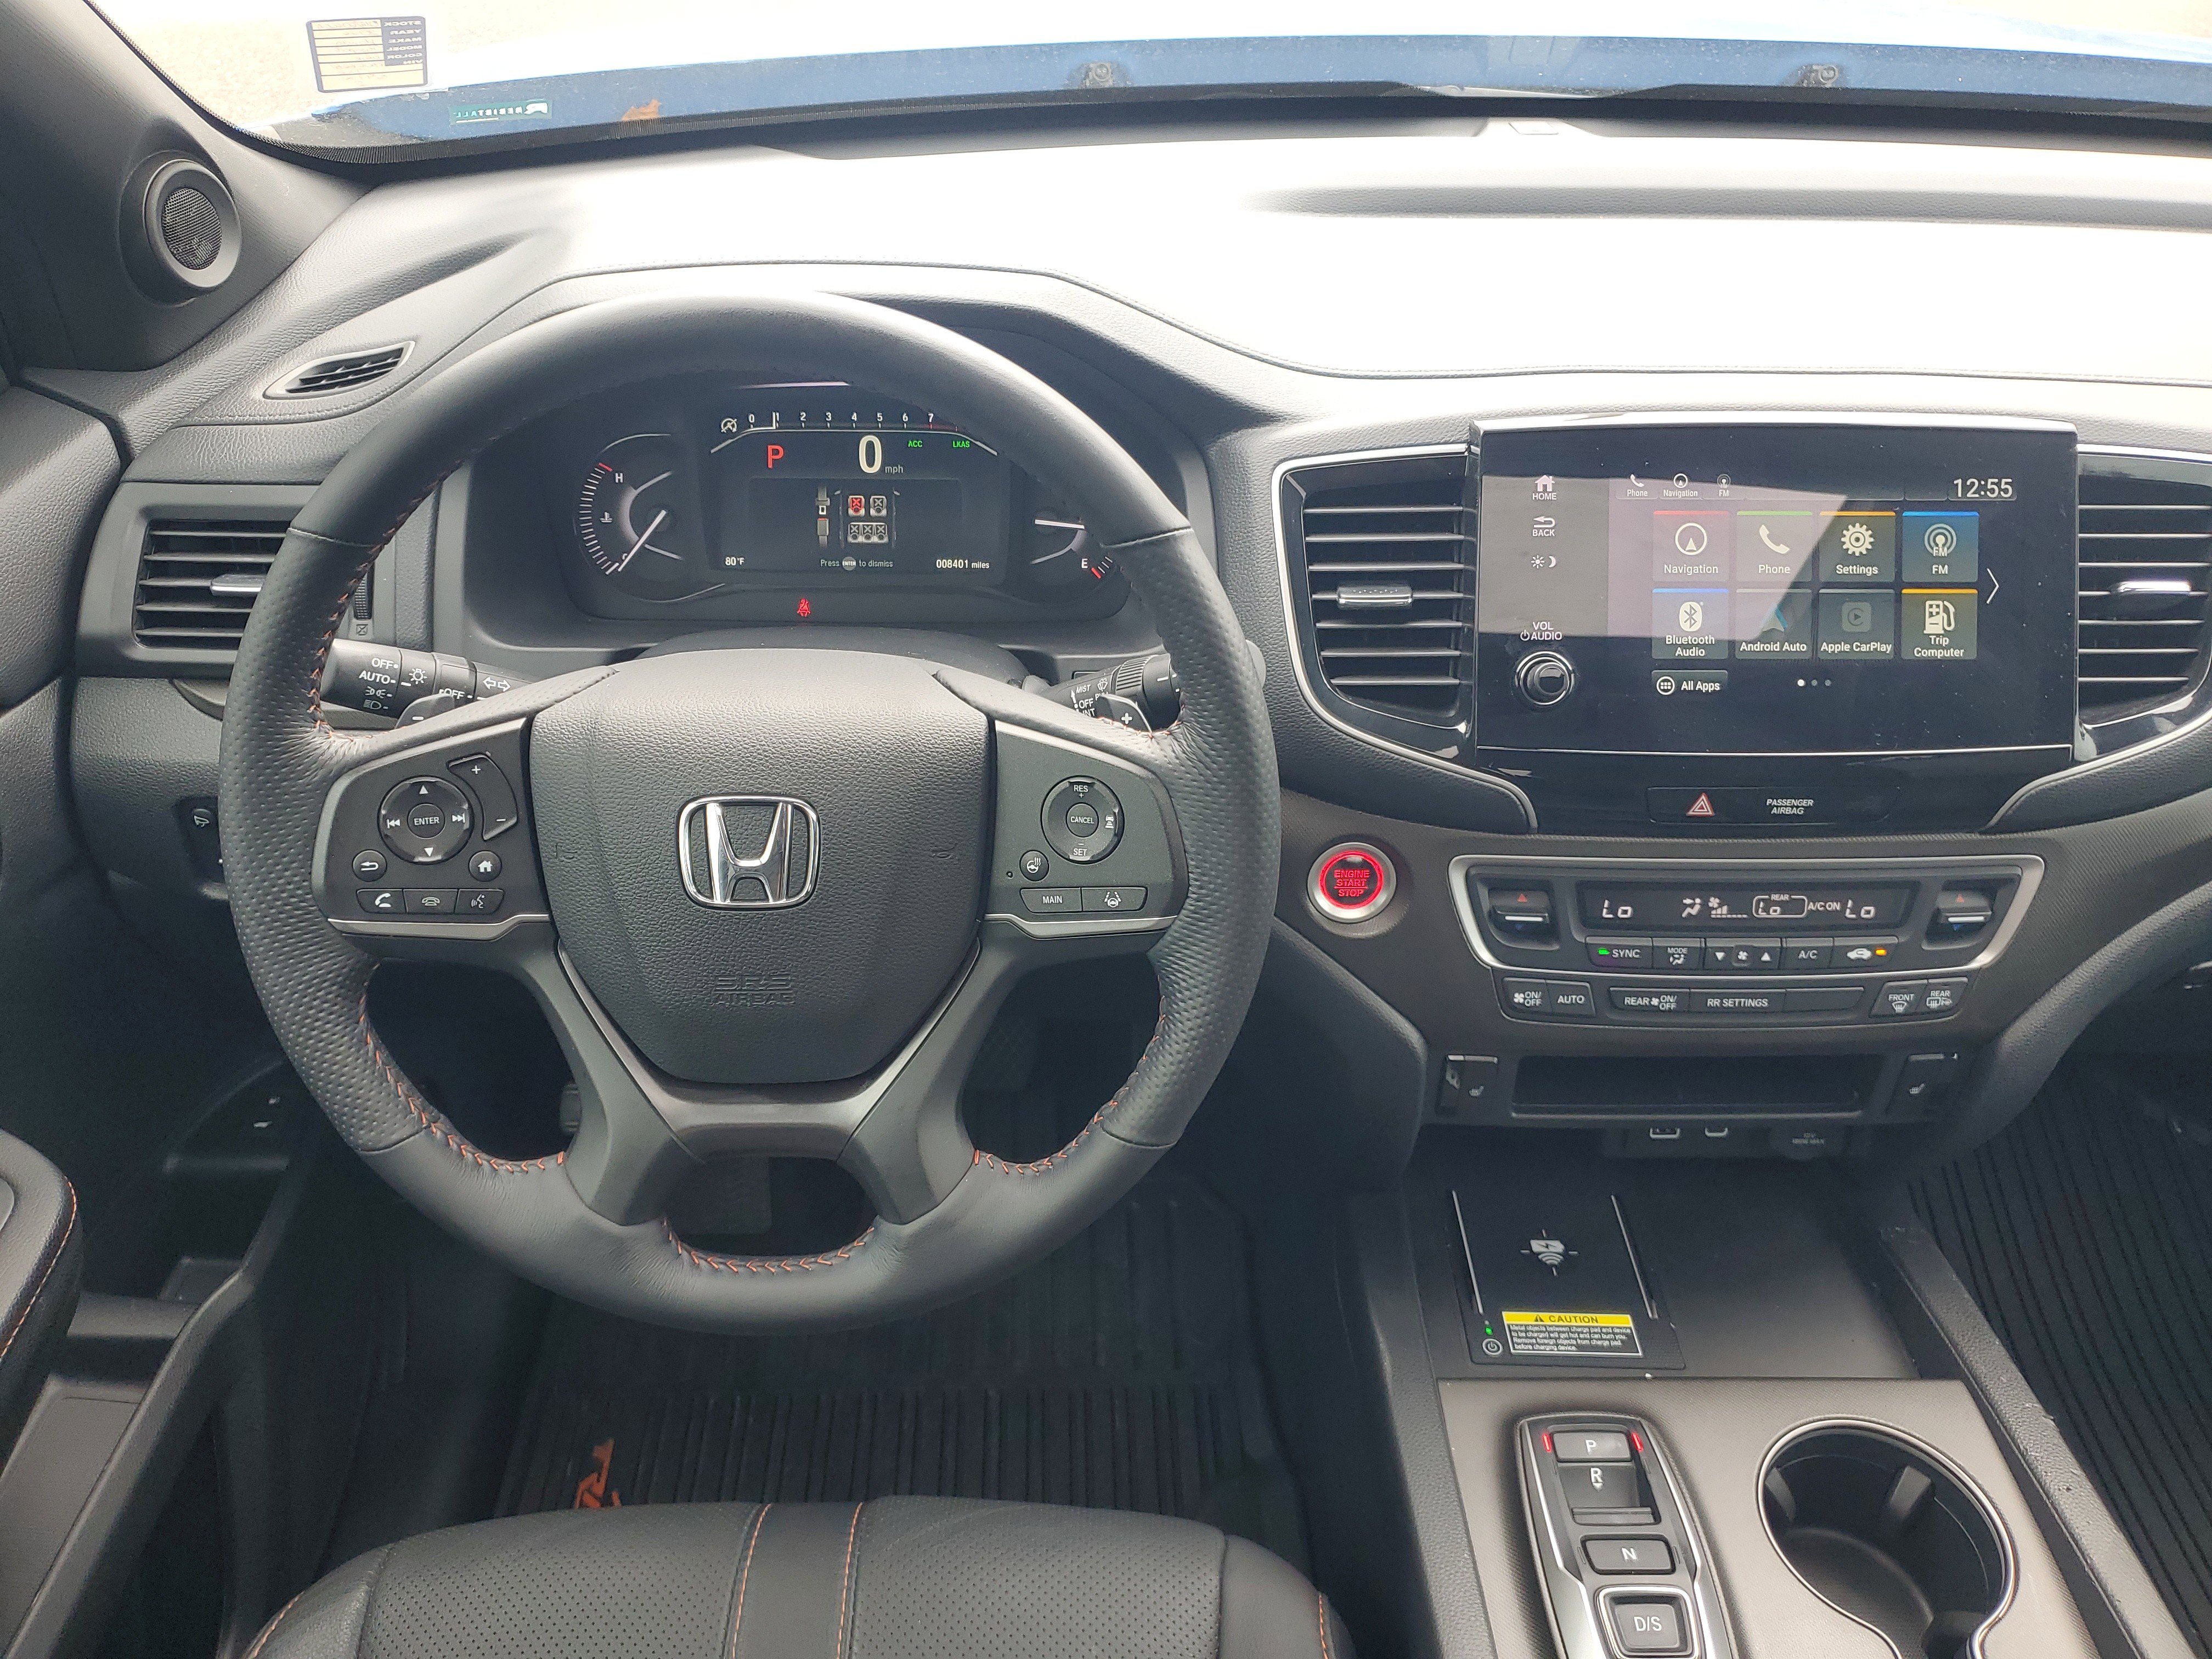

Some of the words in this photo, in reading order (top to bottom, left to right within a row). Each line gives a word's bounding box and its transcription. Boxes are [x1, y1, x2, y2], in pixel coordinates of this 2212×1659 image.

[748, 414, 755, 423] 0
[800, 412, 806, 421] 2
[825, 412, 832, 421] 3
[850, 412, 857, 421] 4
[877, 413, 883, 422] 5
[902, 413, 908, 422] 6
[928, 413, 934, 422] 7
[768, 444, 784, 469] P
[858, 435, 882, 473] 0
[884, 465, 904, 474] mph
[615, 472, 623, 483] H
[1954, 478, 2013, 498] 12:55
[1532, 493, 1557, 501] HOME
[1663, 489, 1698, 498] Navigation
[1532, 529, 1555, 537] BACK
[1933, 547, 1948, 557] FM
[725, 556, 745, 566] 80°F
[820, 559, 840, 568] Press
[868, 559, 894, 568] dismiss
[936, 559, 969, 569] 008401
[971, 560, 990, 570] miles
[1081, 558, 1088, 568] E
[1663, 565, 1719, 575] Navigation
[1758, 565, 1791, 574] Phone
[1836, 564, 1878, 576] Settings
[1932, 565, 1949, 574] FM
[1532, 622, 1554, 631] VOL
[1531, 631, 1562, 641] AUDIO
[1665, 635, 1715, 645] Bluetooth
[1928, 635, 1949, 646] Trip
[1675, 646, 1705, 657] Audio
[1740, 641, 1780, 652] Android
[1782, 642, 1807, 652] Auto
[1820, 642, 1850, 653] Apple
[1853, 642, 1892, 654] CarPlay
[1914, 647, 1965, 658] Computer
[371, 657, 394, 669] OFF
[358, 670, 391, 684] AUTO
[1076, 684, 1091, 694] MIST
[1681, 681, 1694, 691] All
[1696, 681, 1721, 692] Apps
[1079, 698, 1094, 709] OFF
[1074, 785, 1088, 793] RES
[1766, 798, 1814, 806] PASSENGER
[1770, 806, 1805, 815] AIRBAG
[414, 816, 439, 826] ENTER
[1070, 816, 1095, 825] CANCEL
[1073, 848, 1087, 856] SET
[1334, 869, 1370, 878] ENGINE
[1338, 889, 1364, 897] STOP
[1042, 895, 1063, 904] MAIN
[1602, 899, 1634, 919] Lo
[1758, 901, 1781, 915] Lo
[1808, 902, 1826, 911] A/C
[1826, 902, 1841, 911] ON
[1845, 899, 1876, 919] Lo
[1611, 949, 1641, 959] SYNC
[1798, 950, 1818, 960] A/C
[1524, 991, 1542, 999] ON/
[1660, 995, 1678, 1003] ON/
[1888, 993, 1914, 1002] FRONT
[1930, 990, 1951, 998] REAR
[1524, 998, 1542, 1007] OFF
[1557, 995, 1585, 1005] AUTO
[1624, 996, 1650, 1006] REAR
[1707, 998, 1720, 1007] RR
[1722, 998, 1769, 1008] SETTINGS
[1659, 1002, 1677, 1011] OFF
[1548, 1314, 1599, 1324] CAUTION
[1585, 1440, 1597, 1453] P
[1590, 1467, 1603, 1483] R
[1621, 1547, 1638, 1561] N
[1633, 1616, 1662, 1632] D/S
